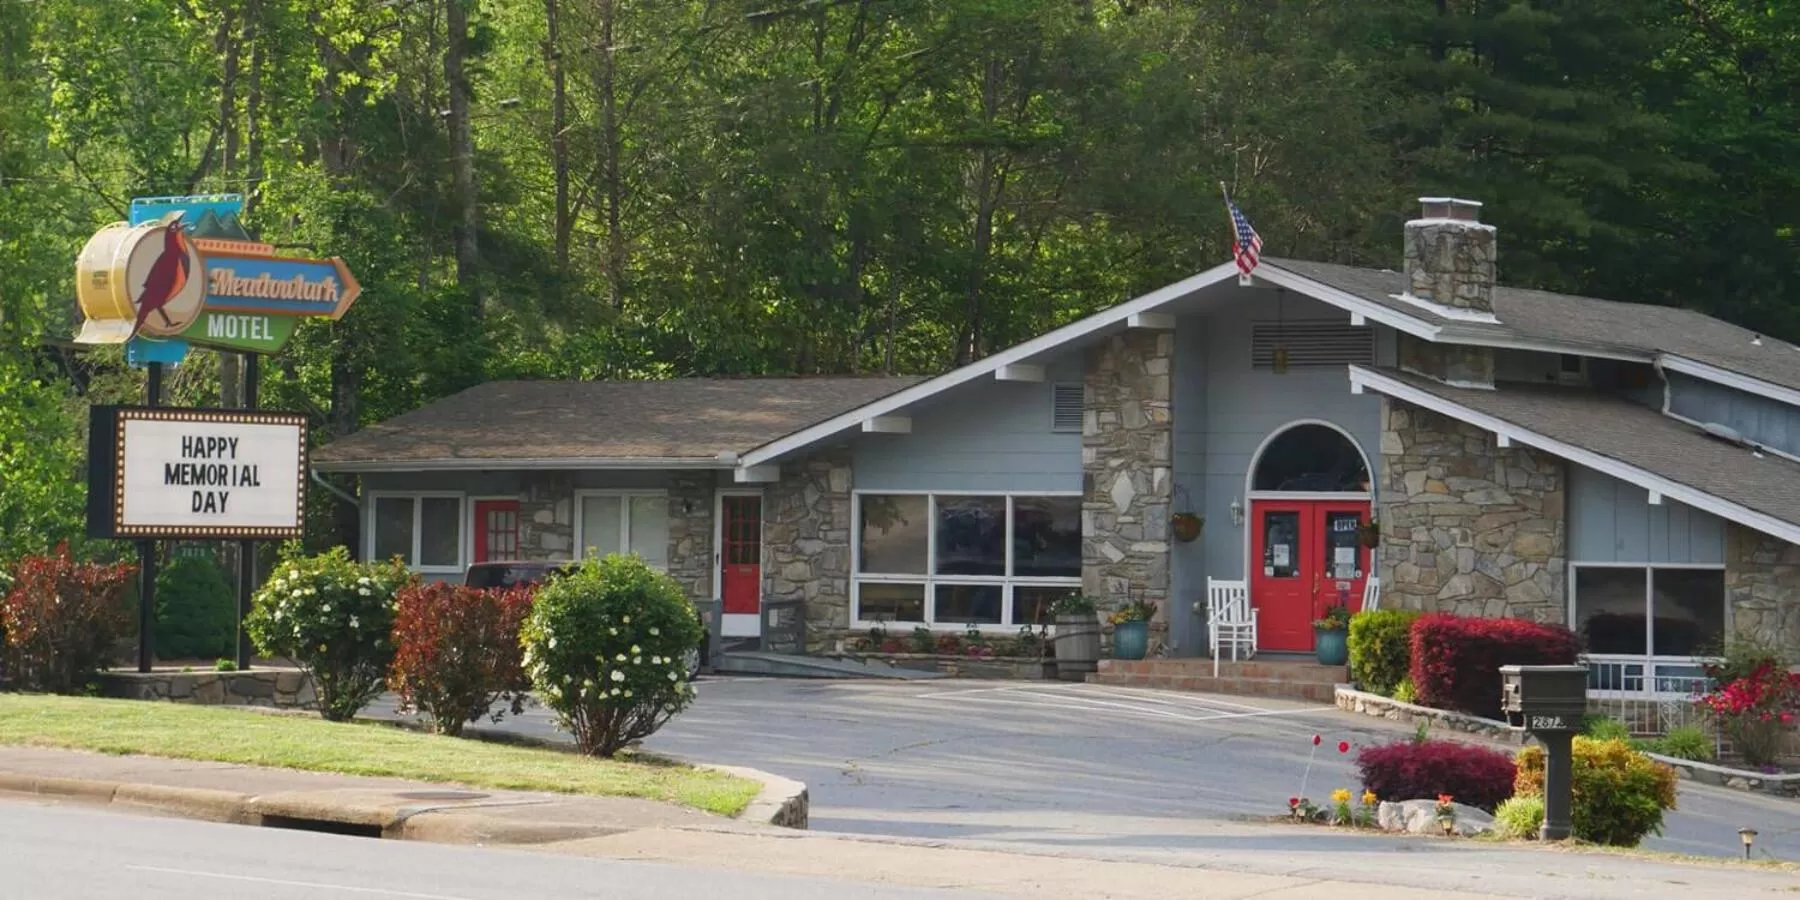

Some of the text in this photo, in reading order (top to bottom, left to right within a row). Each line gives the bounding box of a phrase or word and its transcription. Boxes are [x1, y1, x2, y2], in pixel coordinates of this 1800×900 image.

[209, 267, 338, 302] Meadowlark
[208, 314, 274, 340] MOTEL
[181, 435, 239, 459] HAPPY
[164, 463, 260, 487] MEMORIAL
[191, 491, 229, 514] DAY
